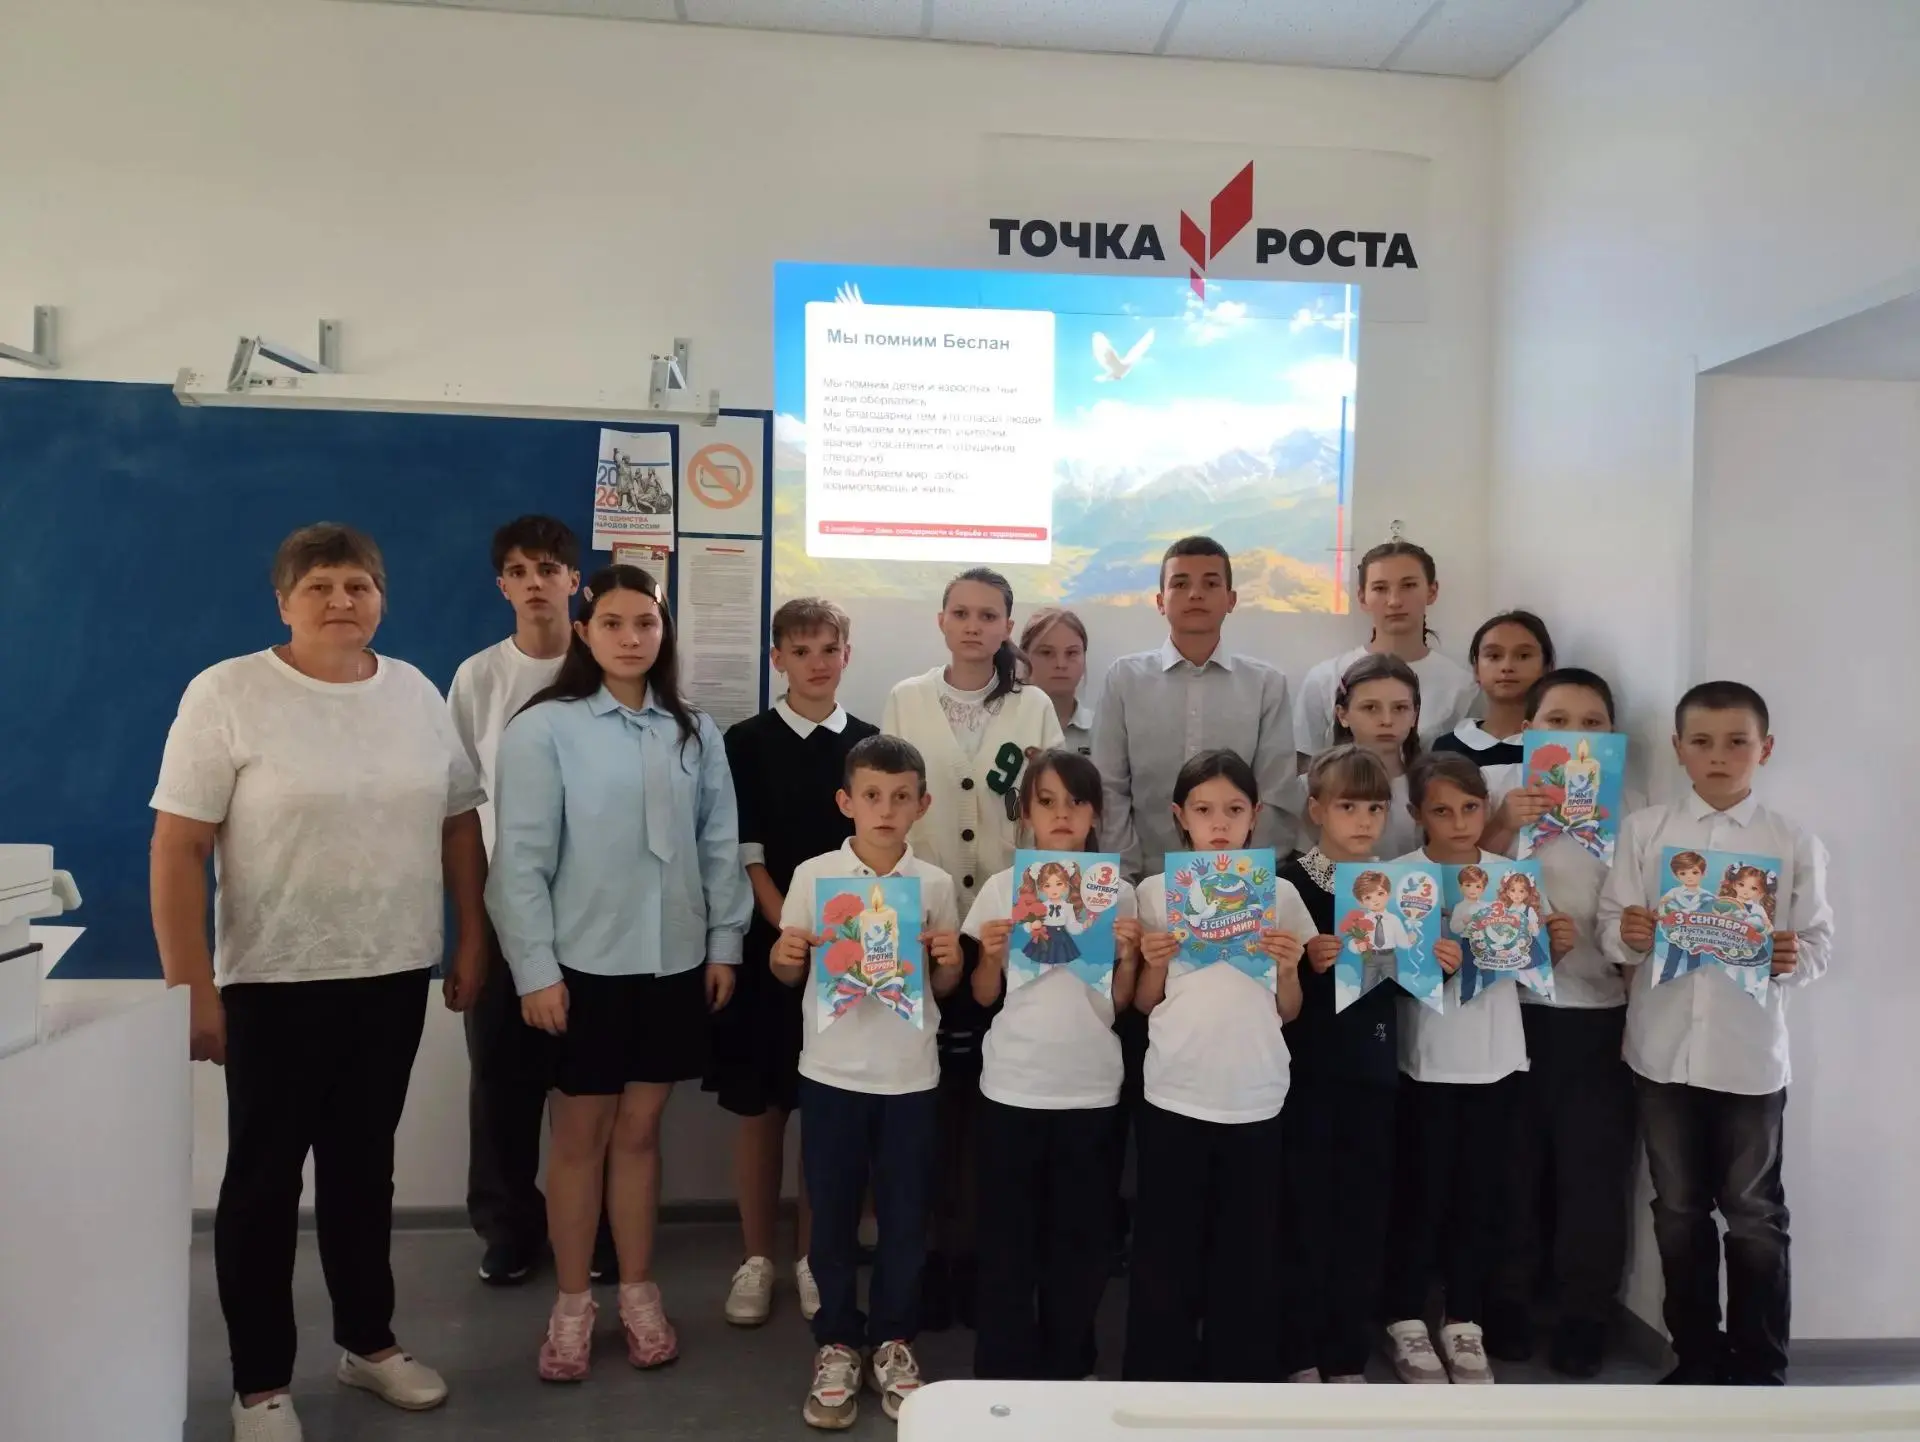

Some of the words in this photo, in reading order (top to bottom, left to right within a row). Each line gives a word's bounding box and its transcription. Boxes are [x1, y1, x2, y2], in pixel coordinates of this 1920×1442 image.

[989, 218, 1165, 261] ТОЧКА
[1256, 228, 1418, 268] РОСТА
[827, 329, 858, 345] Мы
[864, 333, 937, 348] помним
[943, 334, 1010, 351] Беслан
[823, 378, 841, 388] Мы
[845, 380, 889, 391] помним
[823, 408, 841, 417] Мы
[823, 423, 841, 433] Мы
[598, 465, 618, 487] 20
[823, 467, 841, 477] Мы
[596, 486, 618, 508] 26
[986, 742, 1024, 795] 9
[1097, 866, 1112, 885] 3
[1086, 883, 1118, 894] СЕНТЯБРЯ
[1421, 883, 1432, 897] 3
[1490, 902, 1504, 917] 3
[1201, 921, 1209, 930] 3
[1210, 910, 1254, 929] СЕНТЯБРЯ
[1675, 912, 1684, 924] 3
[1689, 915, 1748, 934] СЕНТЯБРЯ
[1201, 931, 1217, 939] МЫ
[1219, 929, 1231, 938] ЗА
[1233, 920, 1256, 933] МИР!
[1680, 926, 1704, 934] Пусть
[867, 952, 893, 962] ПРОТИВ
